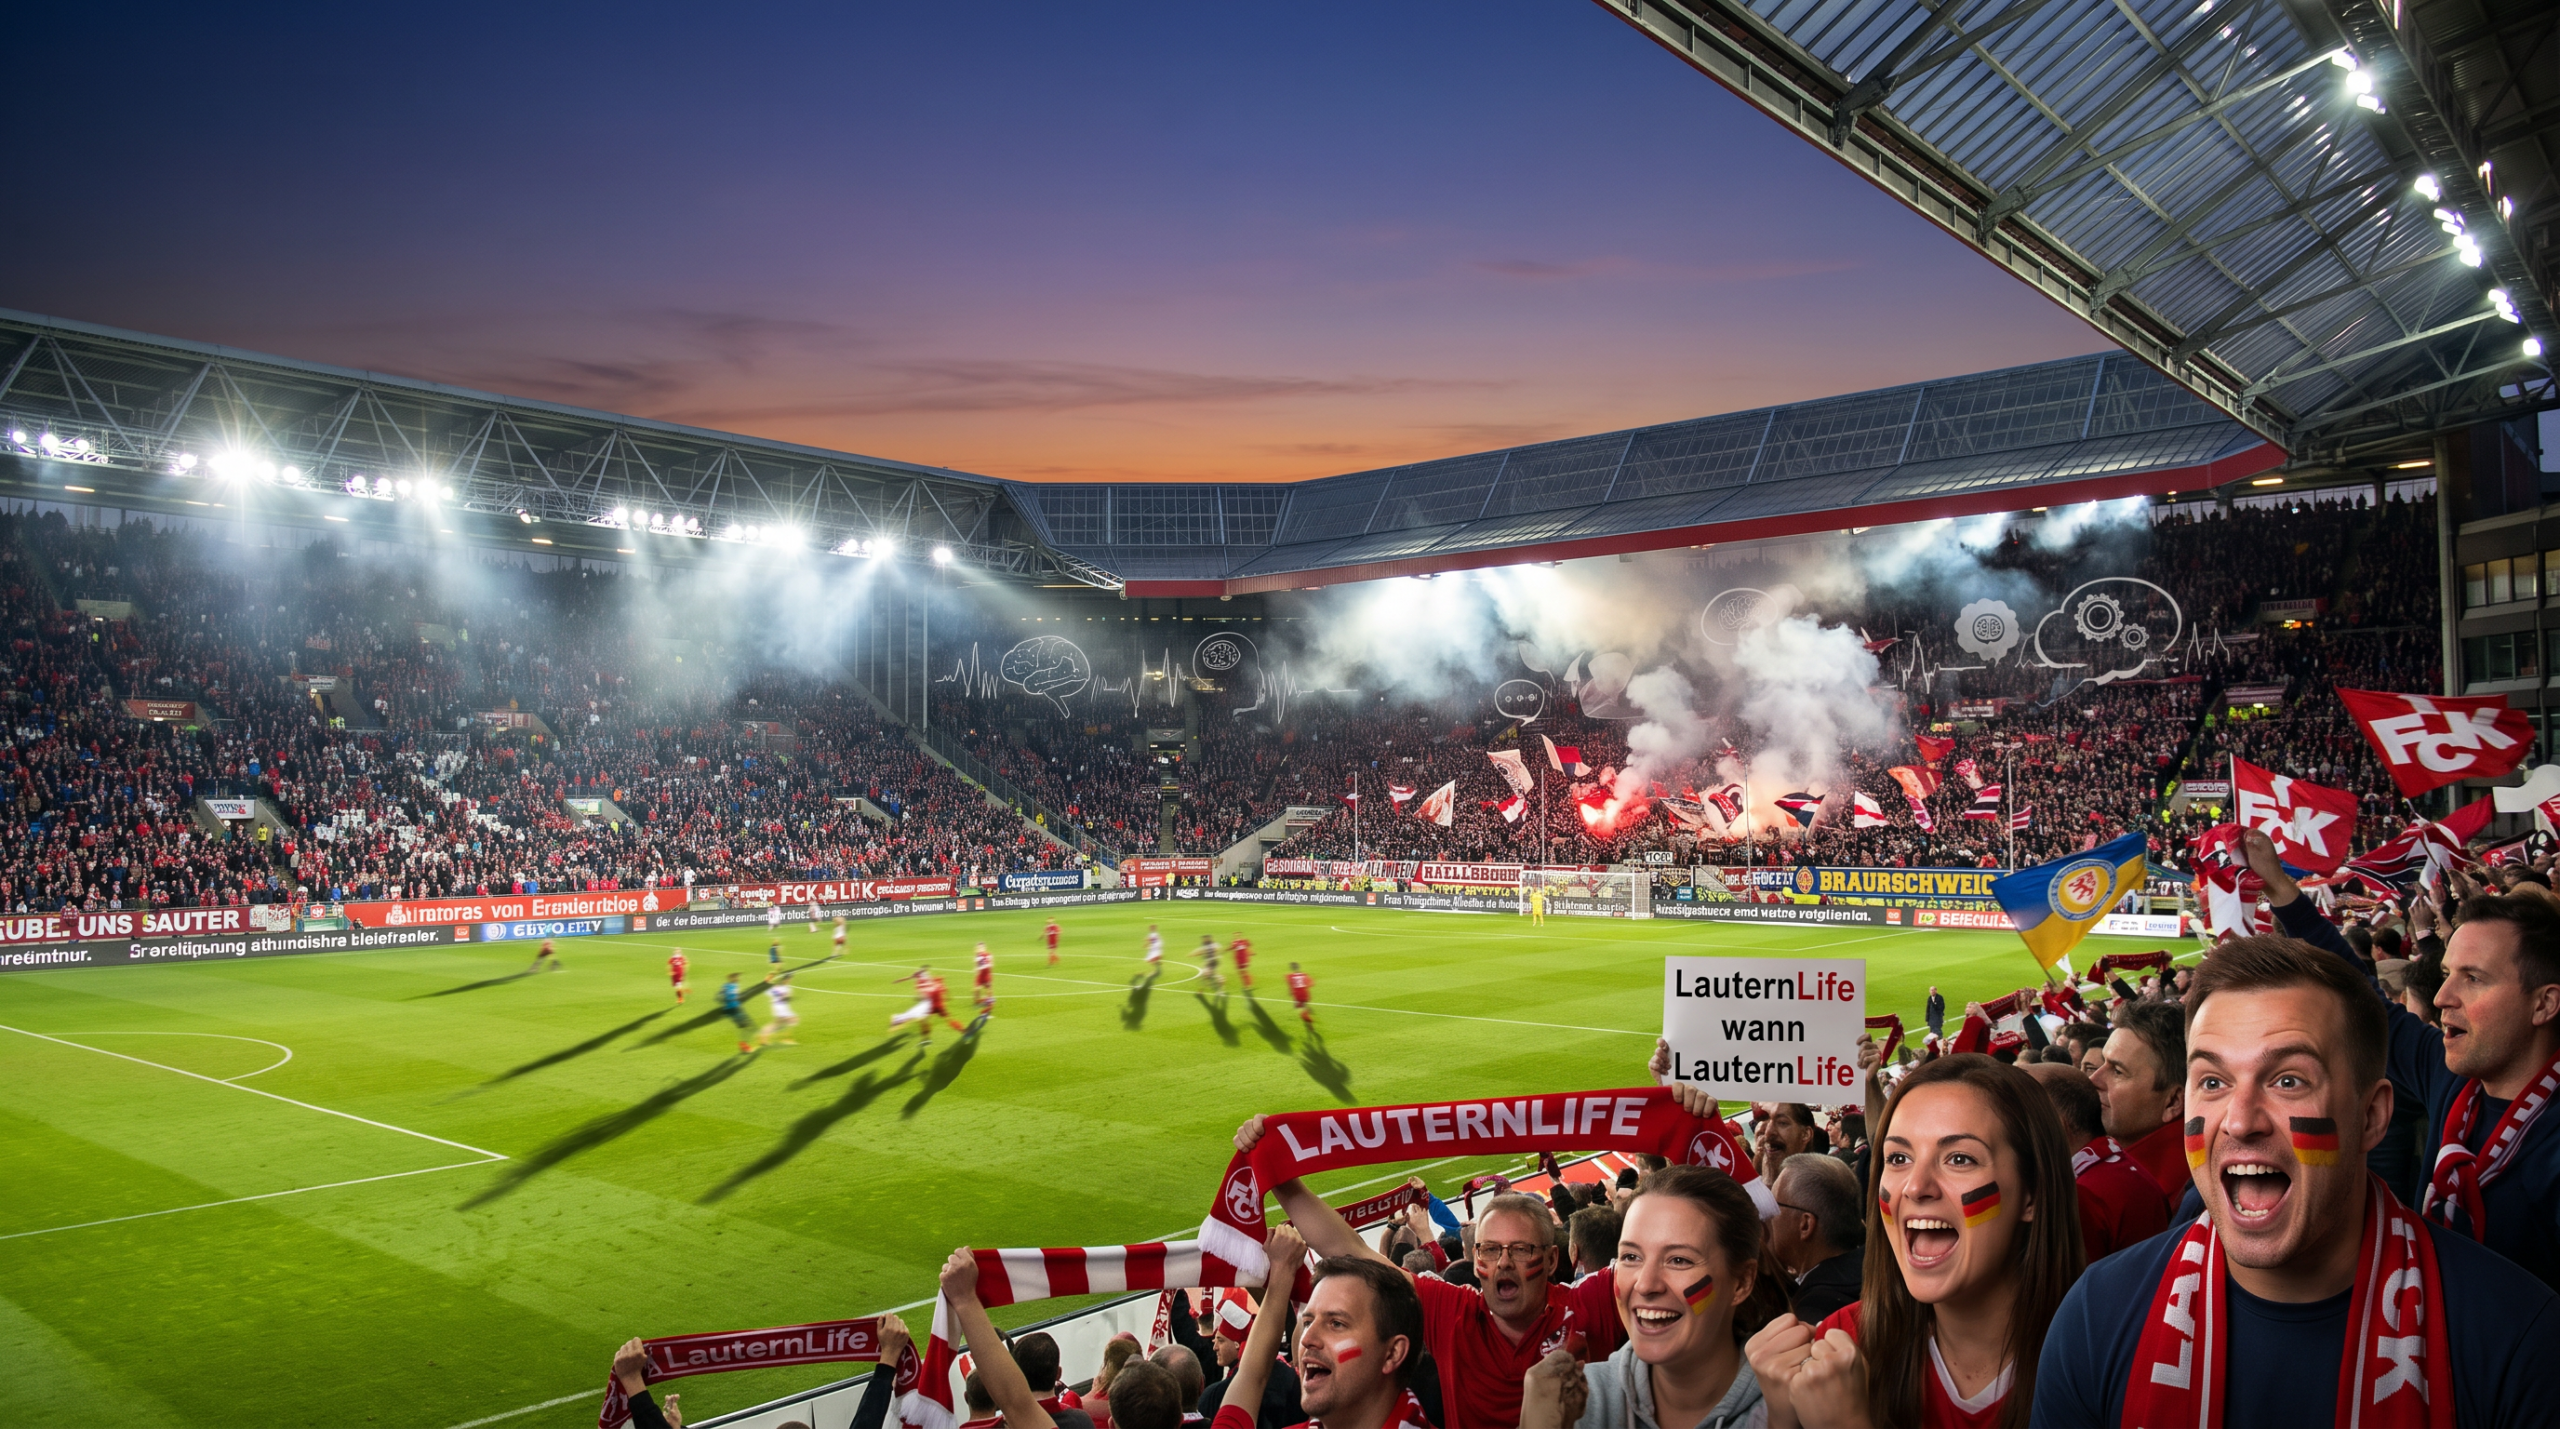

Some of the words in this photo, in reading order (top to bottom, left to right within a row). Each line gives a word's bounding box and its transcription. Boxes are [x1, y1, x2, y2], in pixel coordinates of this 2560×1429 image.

[2369, 706, 2518, 773] FCK
[2238, 788, 2340, 858] FCK
[78, 914, 133, 937] UNS
[142, 910, 240, 933] SAUTER
[491, 903, 524, 918] von
[1676, 968, 1855, 1002] LauternLife
[1721, 1019, 1805, 1042] wann
[1675, 1052, 1855, 1087] LauternLife
[1277, 1097, 1648, 1163] LAUTERNLIFE
[664, 1326, 869, 1369] LauternLife
